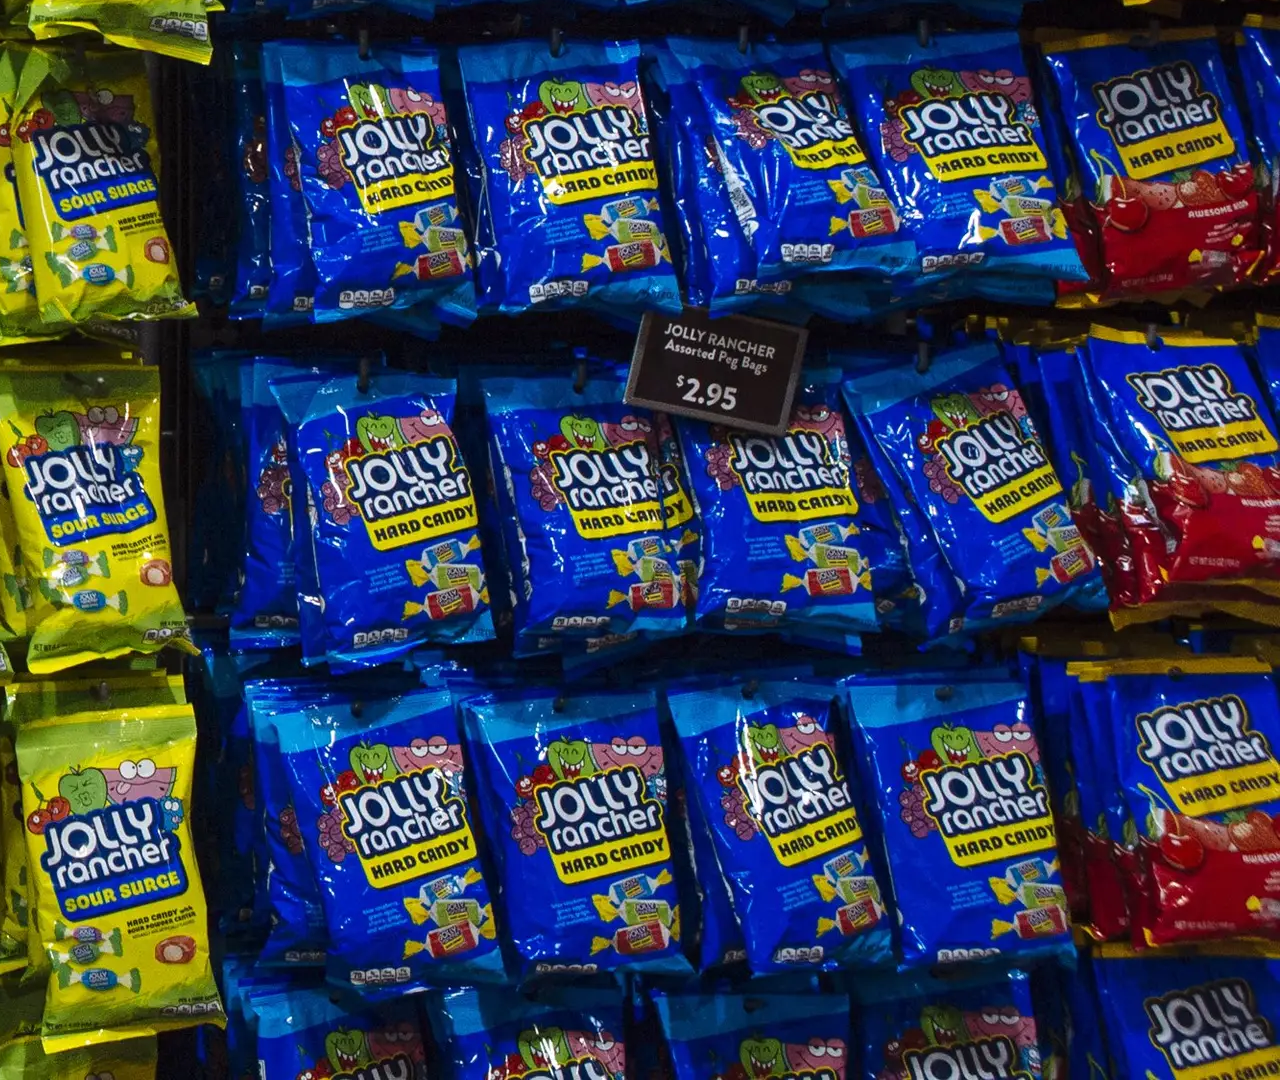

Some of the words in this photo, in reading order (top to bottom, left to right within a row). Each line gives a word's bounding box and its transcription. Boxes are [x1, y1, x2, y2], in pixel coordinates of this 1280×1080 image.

[1098, 67, 1193, 123] JOLLY
[906, 96, 1008, 140] JOLLY
[1115, 98, 1213, 143] rancher
[922, 124, 1029, 155] rancher
[1128, 146, 1175, 169] HARD
[1177, 133, 1224, 155] CANDY
[936, 157, 985, 173] HARD
[987, 152, 1040, 165] CANDY
[664, 323, 707, 343] JOLLY
[708, 333, 776, 359] RANCHER
[665, 339, 716, 361] Assorted
[718, 350, 738, 370] Peg
[742, 356, 768, 376] Bags
[676, 374, 737, 410] $2.95
[351, 441, 448, 498] JOLLY
[364, 473, 467, 518] rancher
[374, 520, 421, 542] HARD
[423, 504, 473, 527] CANDY
[1140, 701, 1241, 758] JOLLY
[1159, 737, 1266, 779] rancher
[541, 771, 639, 829] JOLLY
[1179, 783, 1227, 806] HARD
[1229, 772, 1280, 794] CANDY
[47, 803, 153, 866] JOLLY
[552, 805, 657, 850] rancher
[56, 838, 170, 888] rancher
[560, 853, 608, 875] HARD
[610, 838, 664, 862] CANDY
[64, 887, 117, 913] SOUR
[119, 871, 181, 899] SURGE
[126, 917, 150, 928] HARD
[151, 909, 178, 921] CANDY
